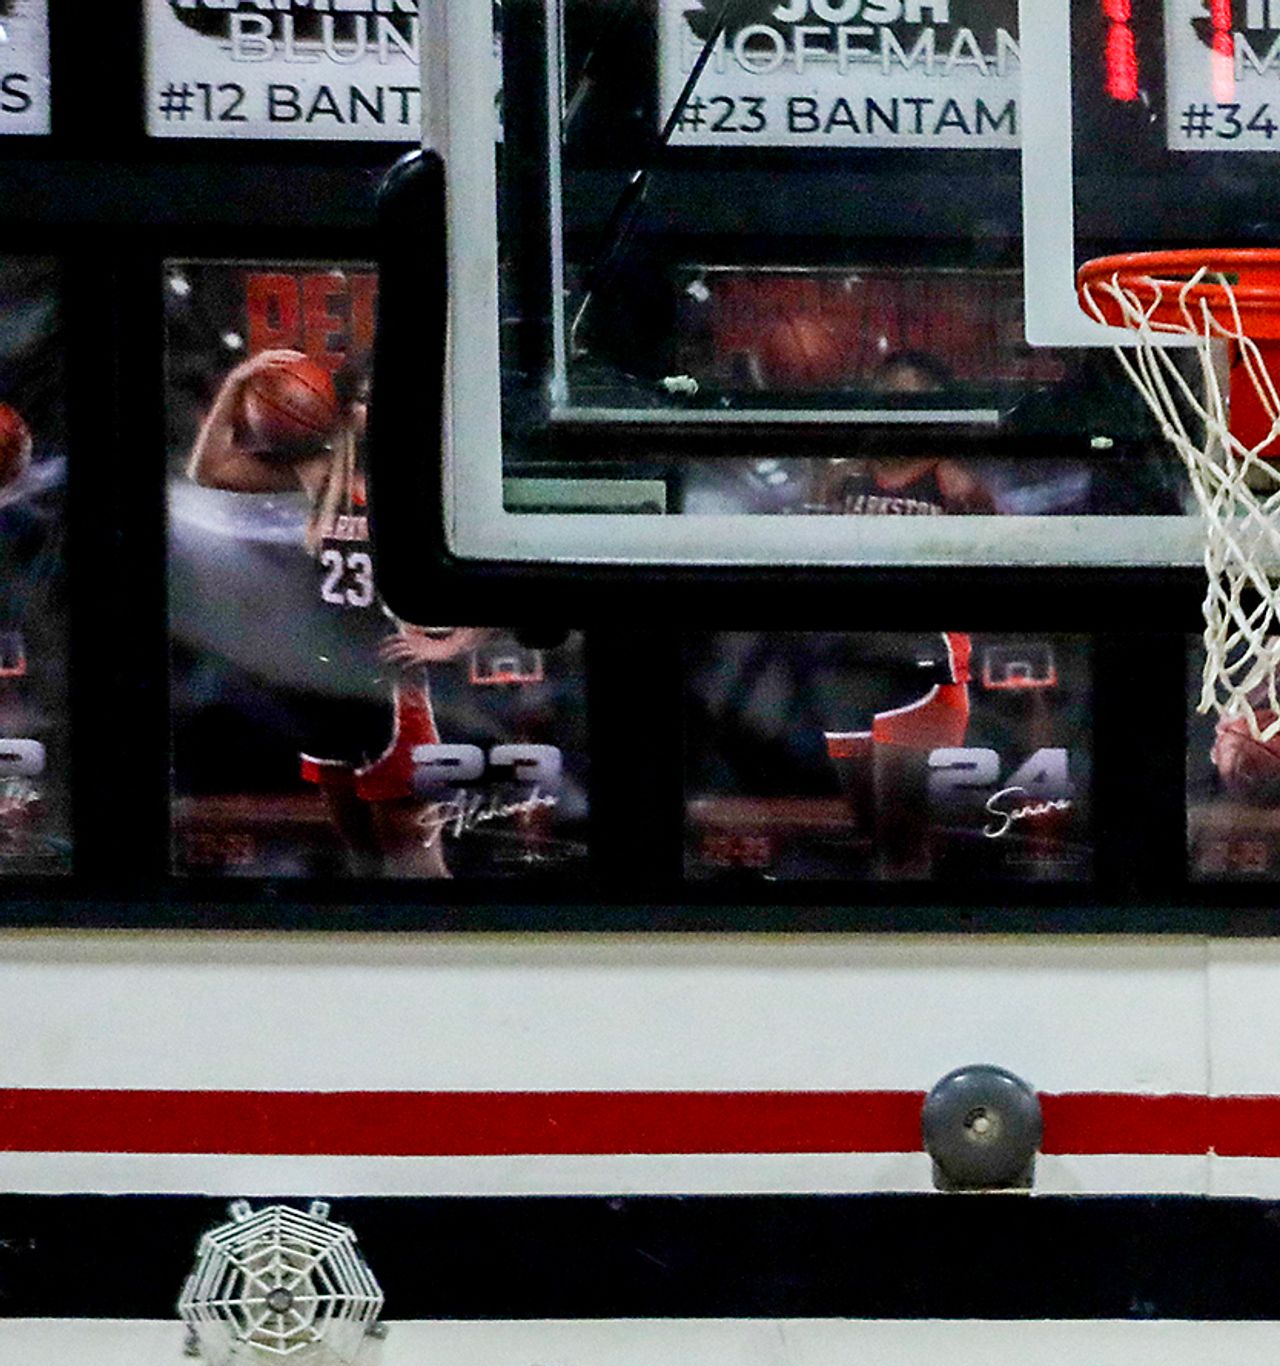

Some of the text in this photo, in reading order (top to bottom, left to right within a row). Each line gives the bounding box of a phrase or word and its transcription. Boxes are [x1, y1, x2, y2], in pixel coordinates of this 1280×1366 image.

[158, 82, 248, 123] #12
[677, 95, 768, 134] #23
[1180, 102, 1279, 140] #34
